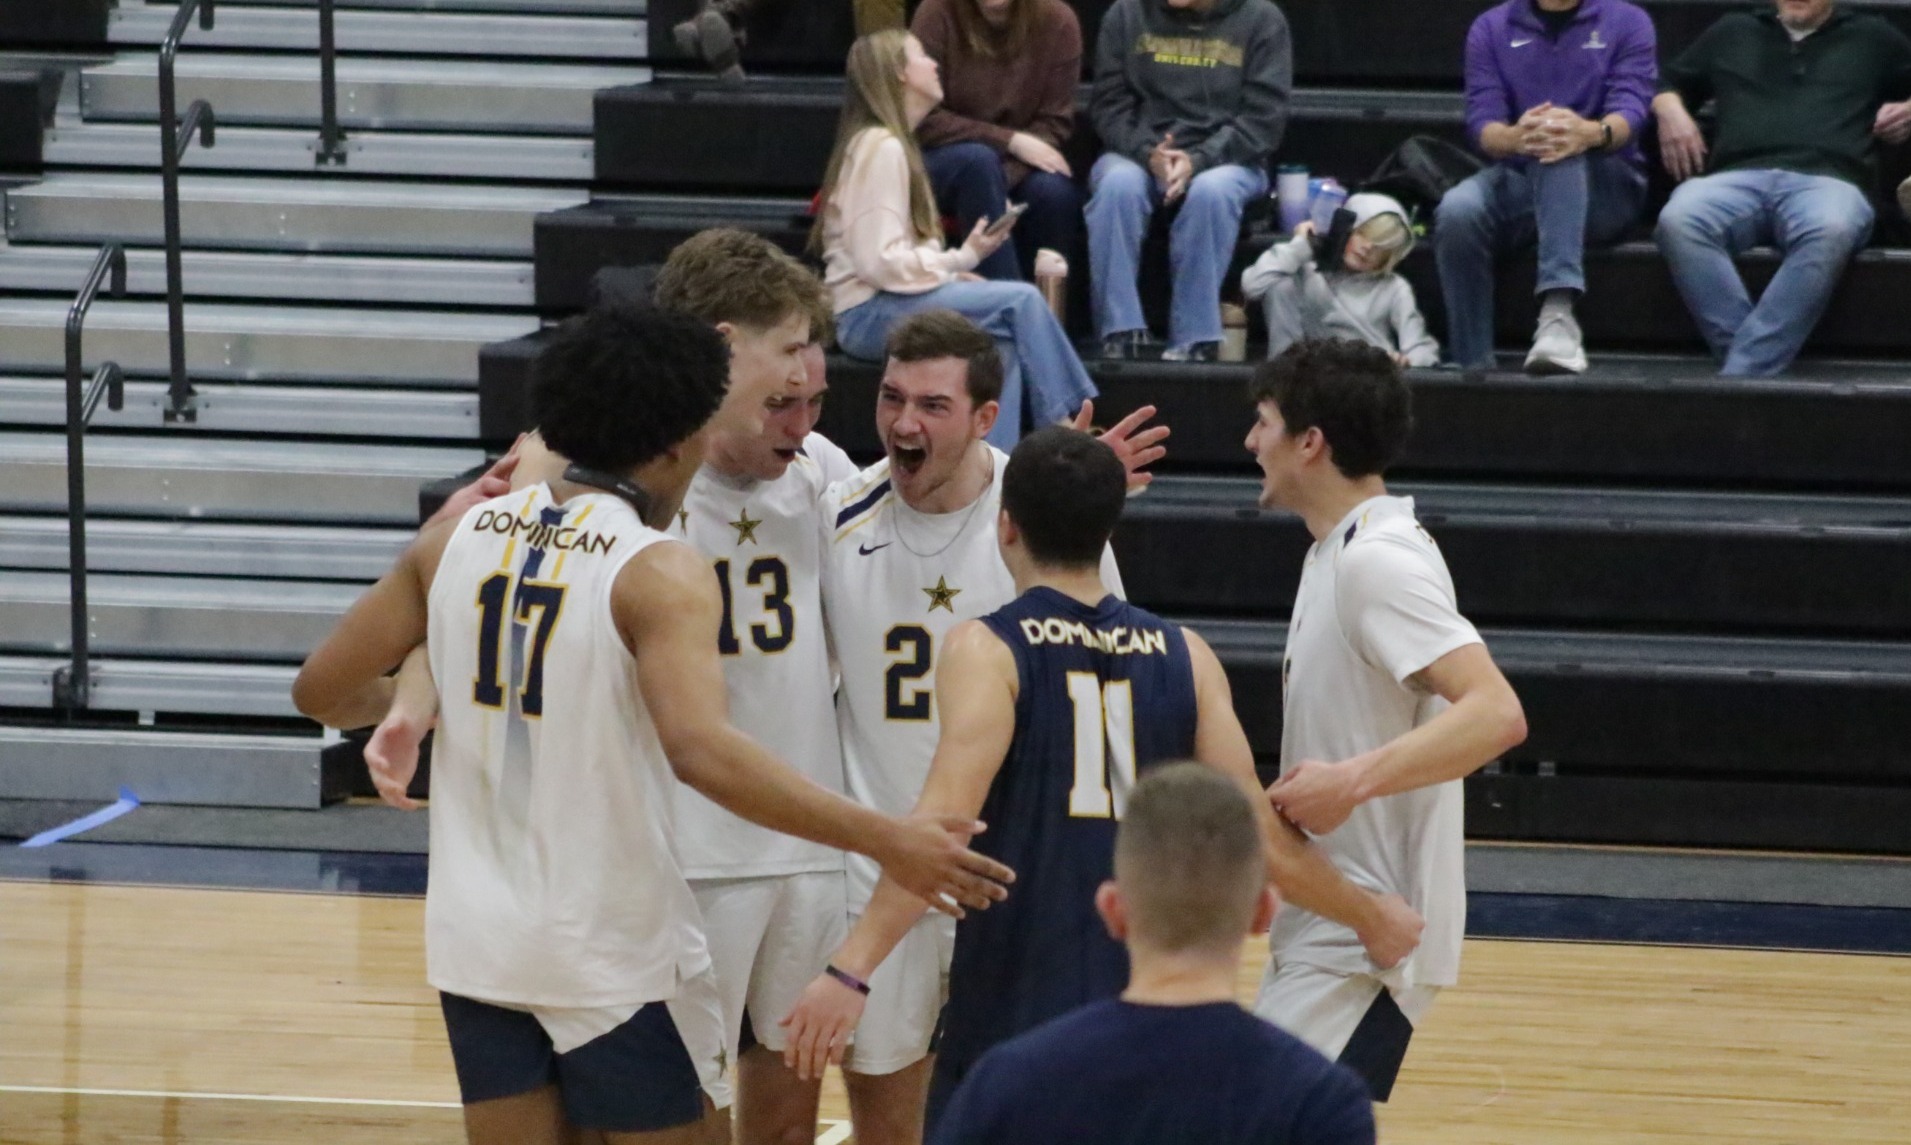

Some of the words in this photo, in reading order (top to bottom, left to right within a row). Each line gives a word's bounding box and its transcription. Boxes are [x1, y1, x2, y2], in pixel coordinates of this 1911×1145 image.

[471, 569, 569, 721] 17
[713, 554, 795, 657] 13
[883, 622, 934, 723] 2
[1066, 670, 1137, 822] 11
